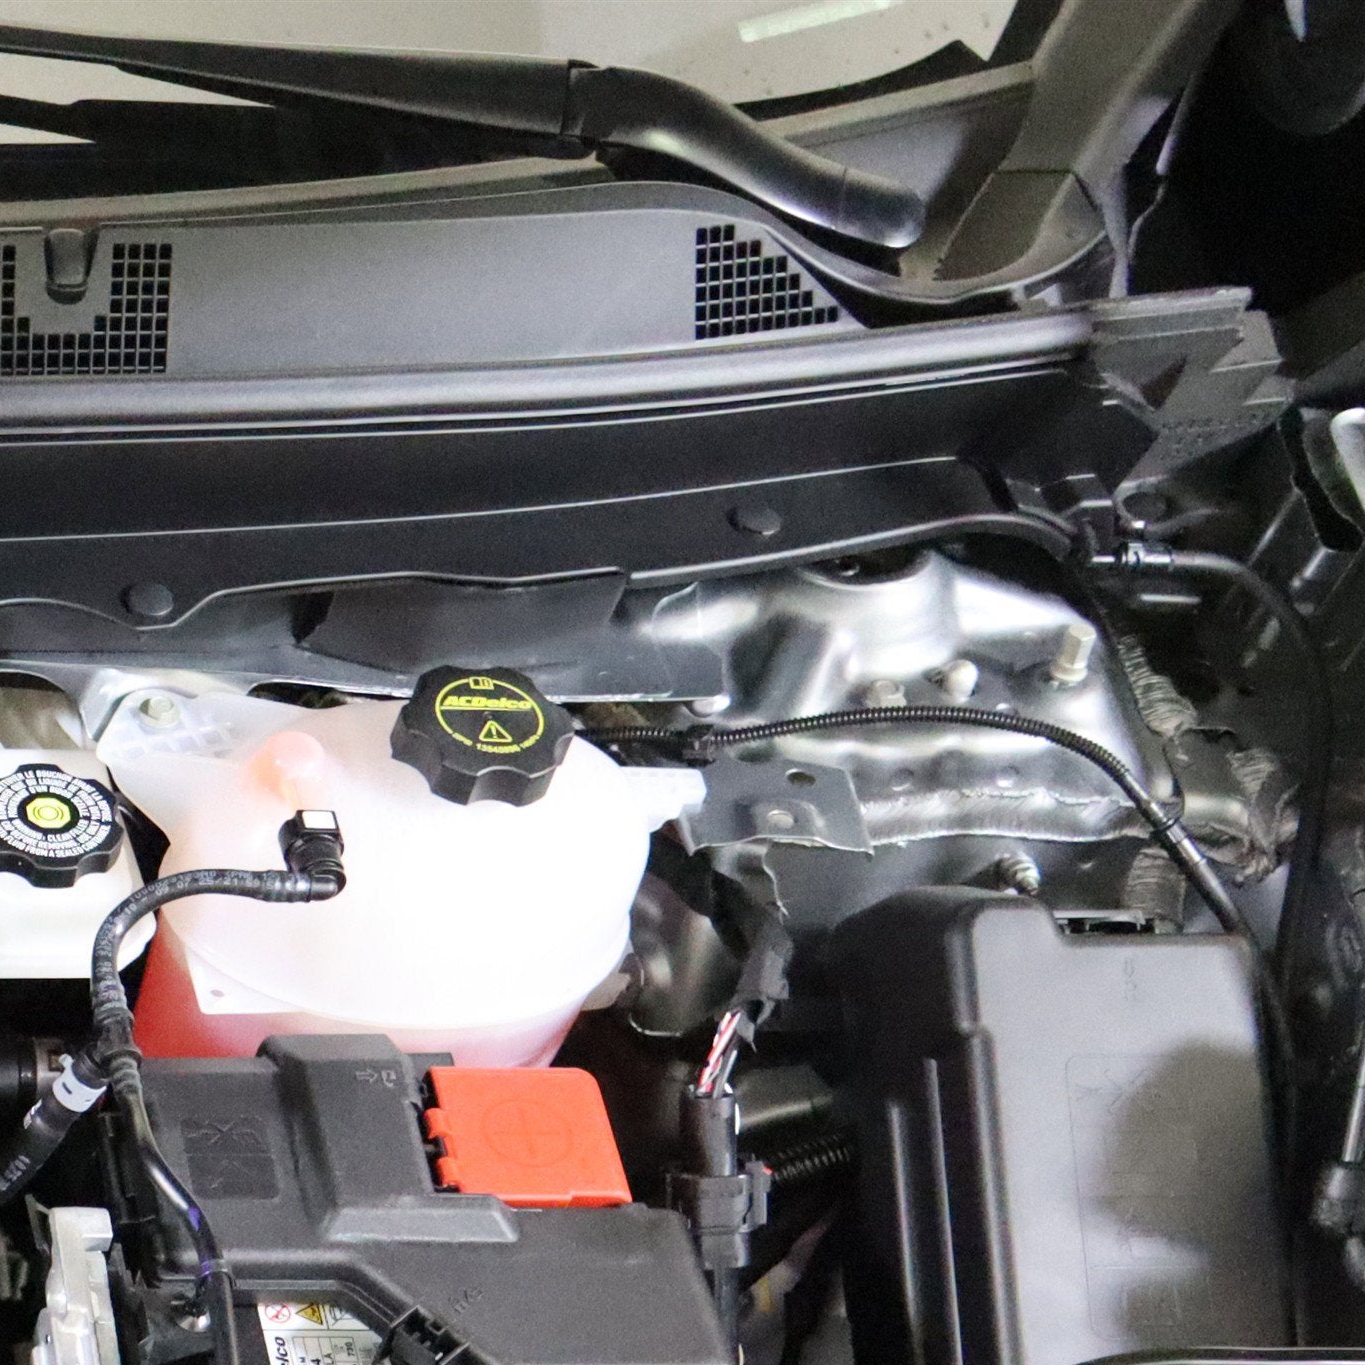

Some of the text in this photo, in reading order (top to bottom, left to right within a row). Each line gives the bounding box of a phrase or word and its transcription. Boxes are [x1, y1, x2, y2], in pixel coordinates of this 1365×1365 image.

[443, 695, 533, 709] ACDelco
[24, 770, 35, 779] LE
[36, 770, 73, 782] BOUCHON
[10, 830, 39, 847] BEFORE
[47, 831, 73, 842] CLEAN
[4, 835, 26, 850] FLUID
[25, 846, 48, 857] FROM
[49, 849, 55, 857] A
[55, 847, 83, 858] SEALED
